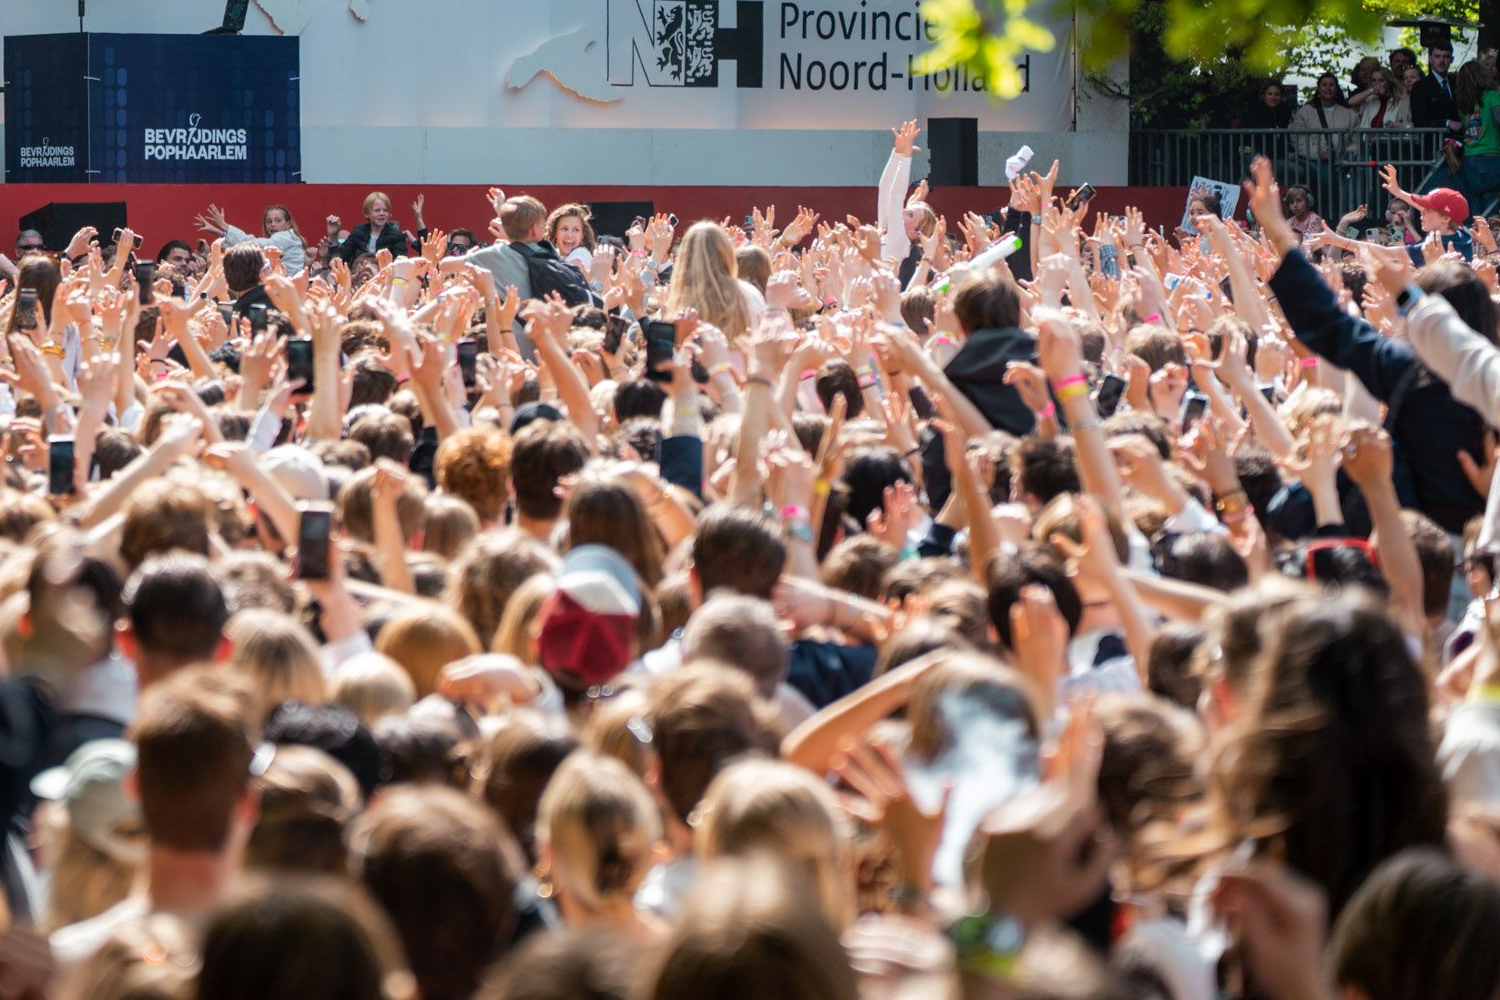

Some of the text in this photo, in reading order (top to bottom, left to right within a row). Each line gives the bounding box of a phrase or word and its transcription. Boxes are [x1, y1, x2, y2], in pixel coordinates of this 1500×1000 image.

[144, 127, 247, 145] BEVRIJDINGS
[20, 146, 75, 157] BEVRIJDINGS
[144, 145, 248, 160] POPHAARLEM
[20, 157, 75, 167] POPHAARLEM
